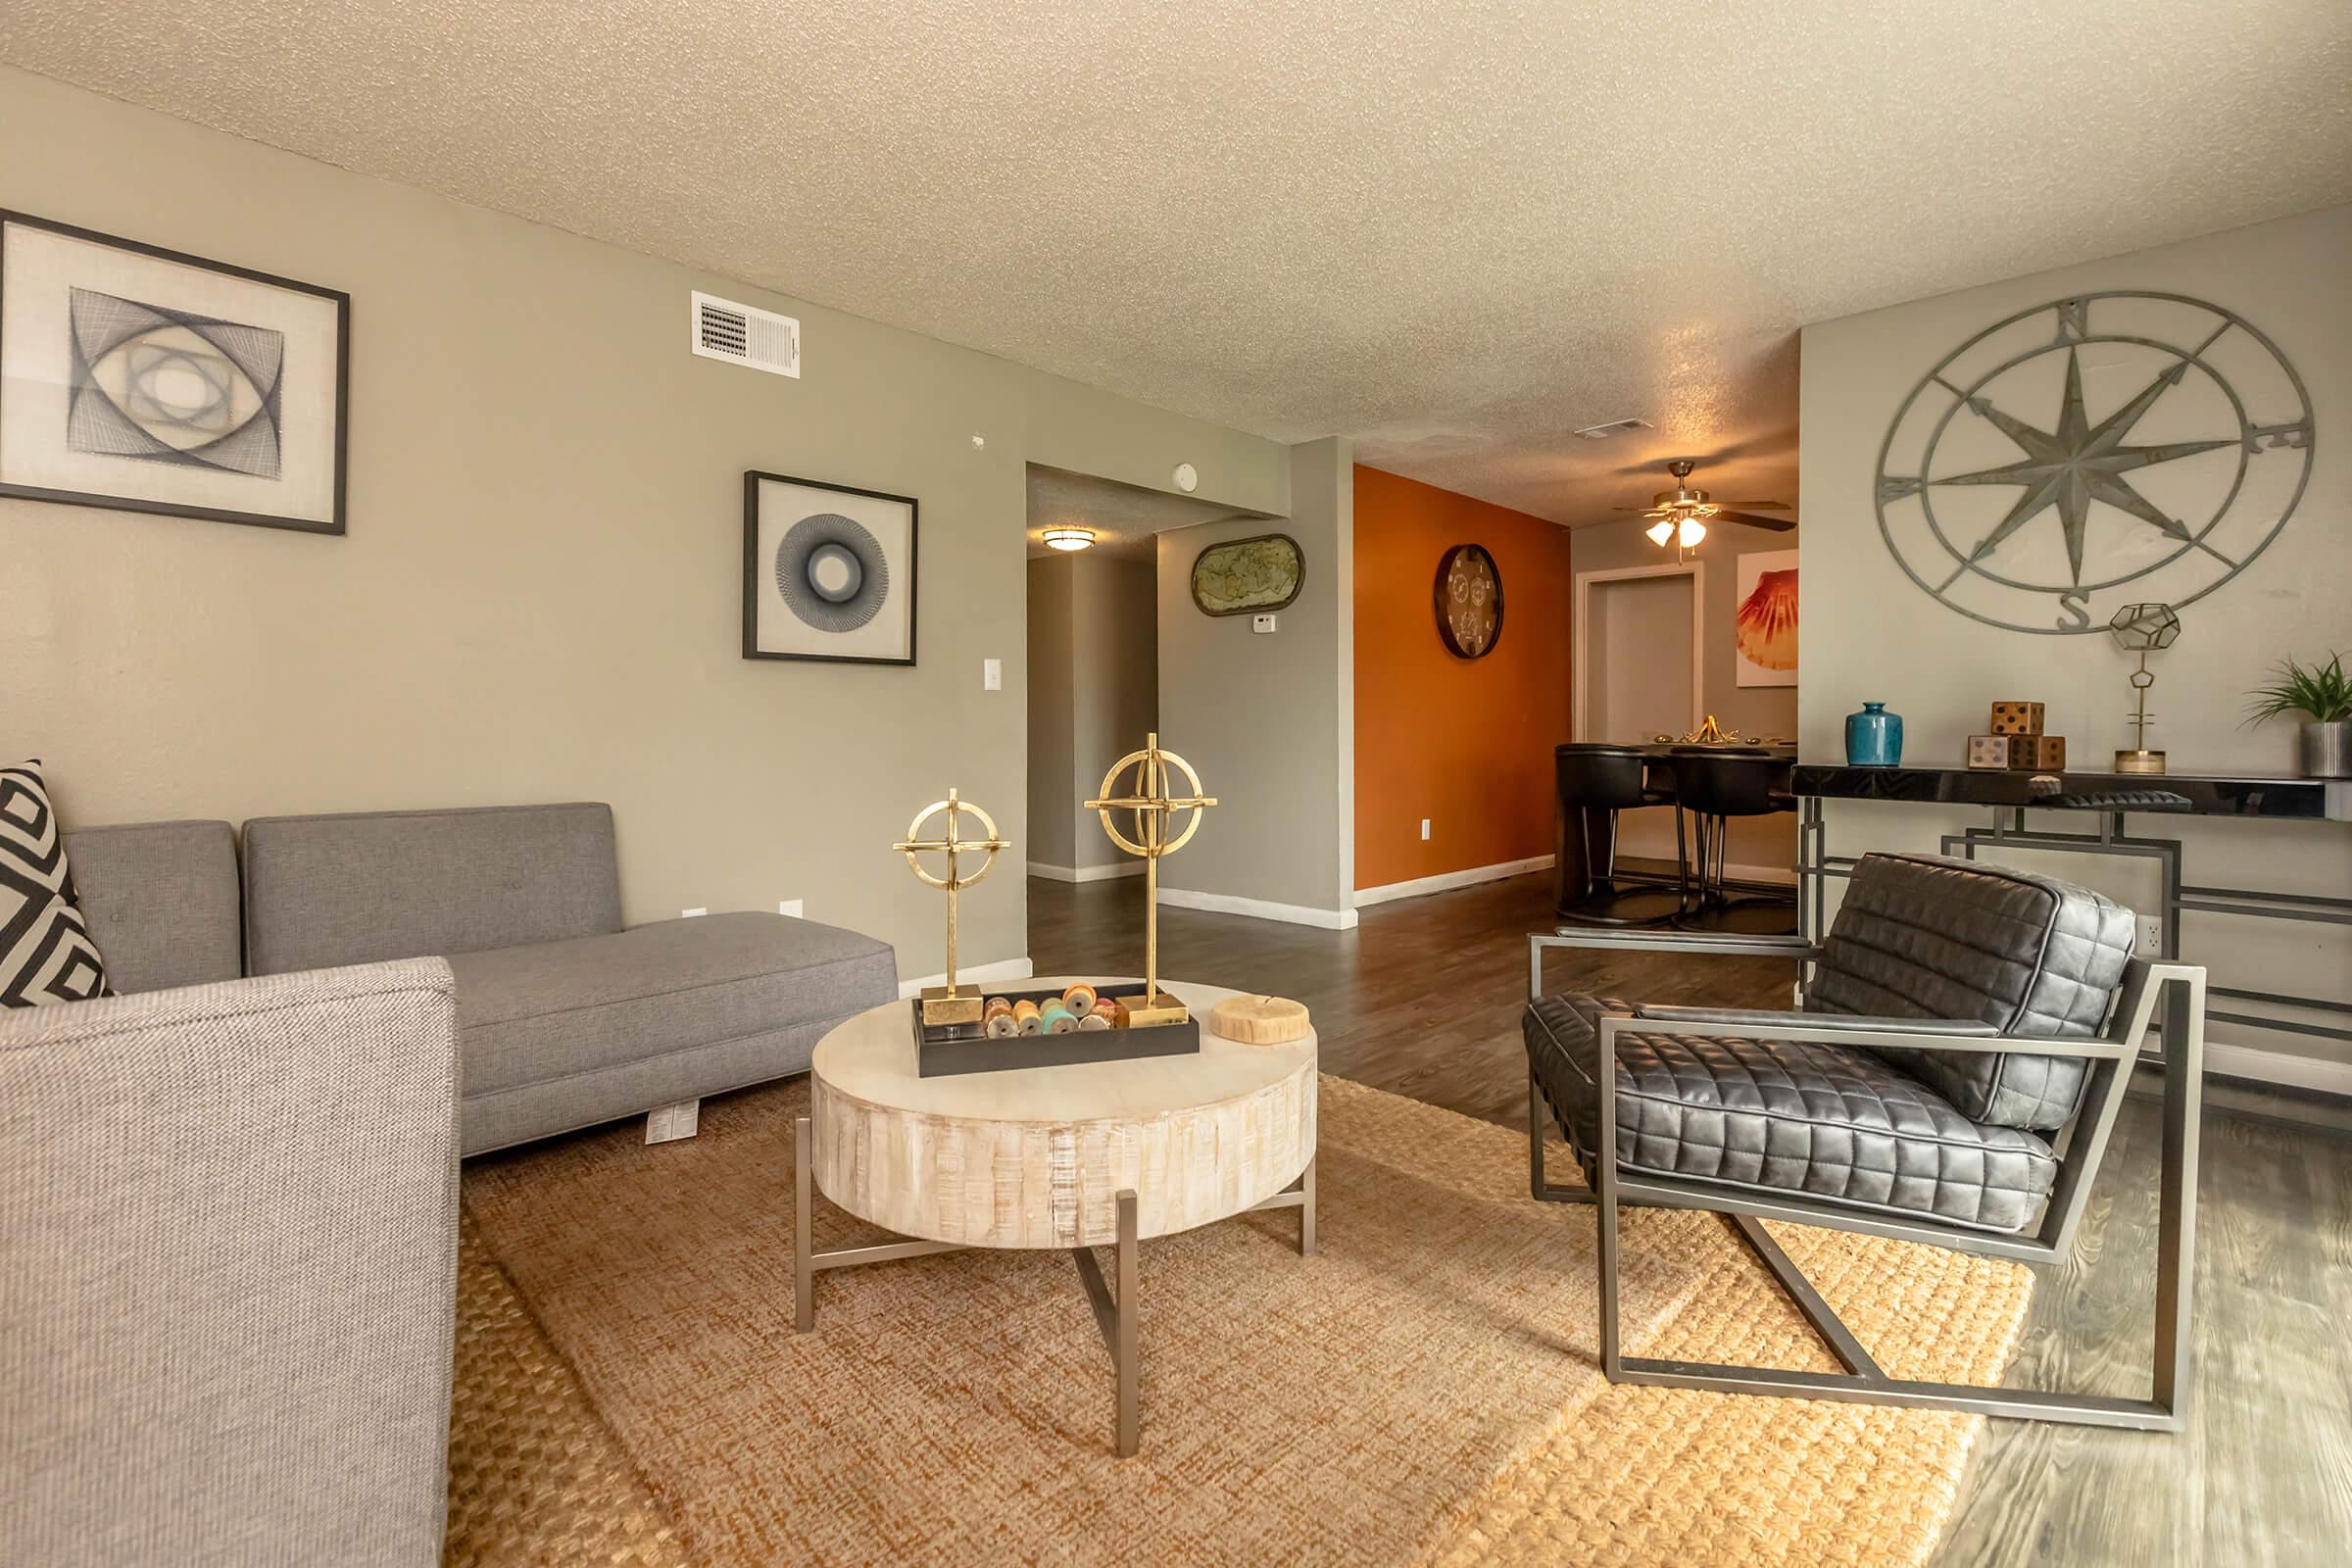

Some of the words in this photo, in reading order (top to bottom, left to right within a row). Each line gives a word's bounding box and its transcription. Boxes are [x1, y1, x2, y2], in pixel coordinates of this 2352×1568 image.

[2055, 298, 2089, 346] N
[2242, 418, 2312, 454] E
[2057, 588, 2090, 634] S
